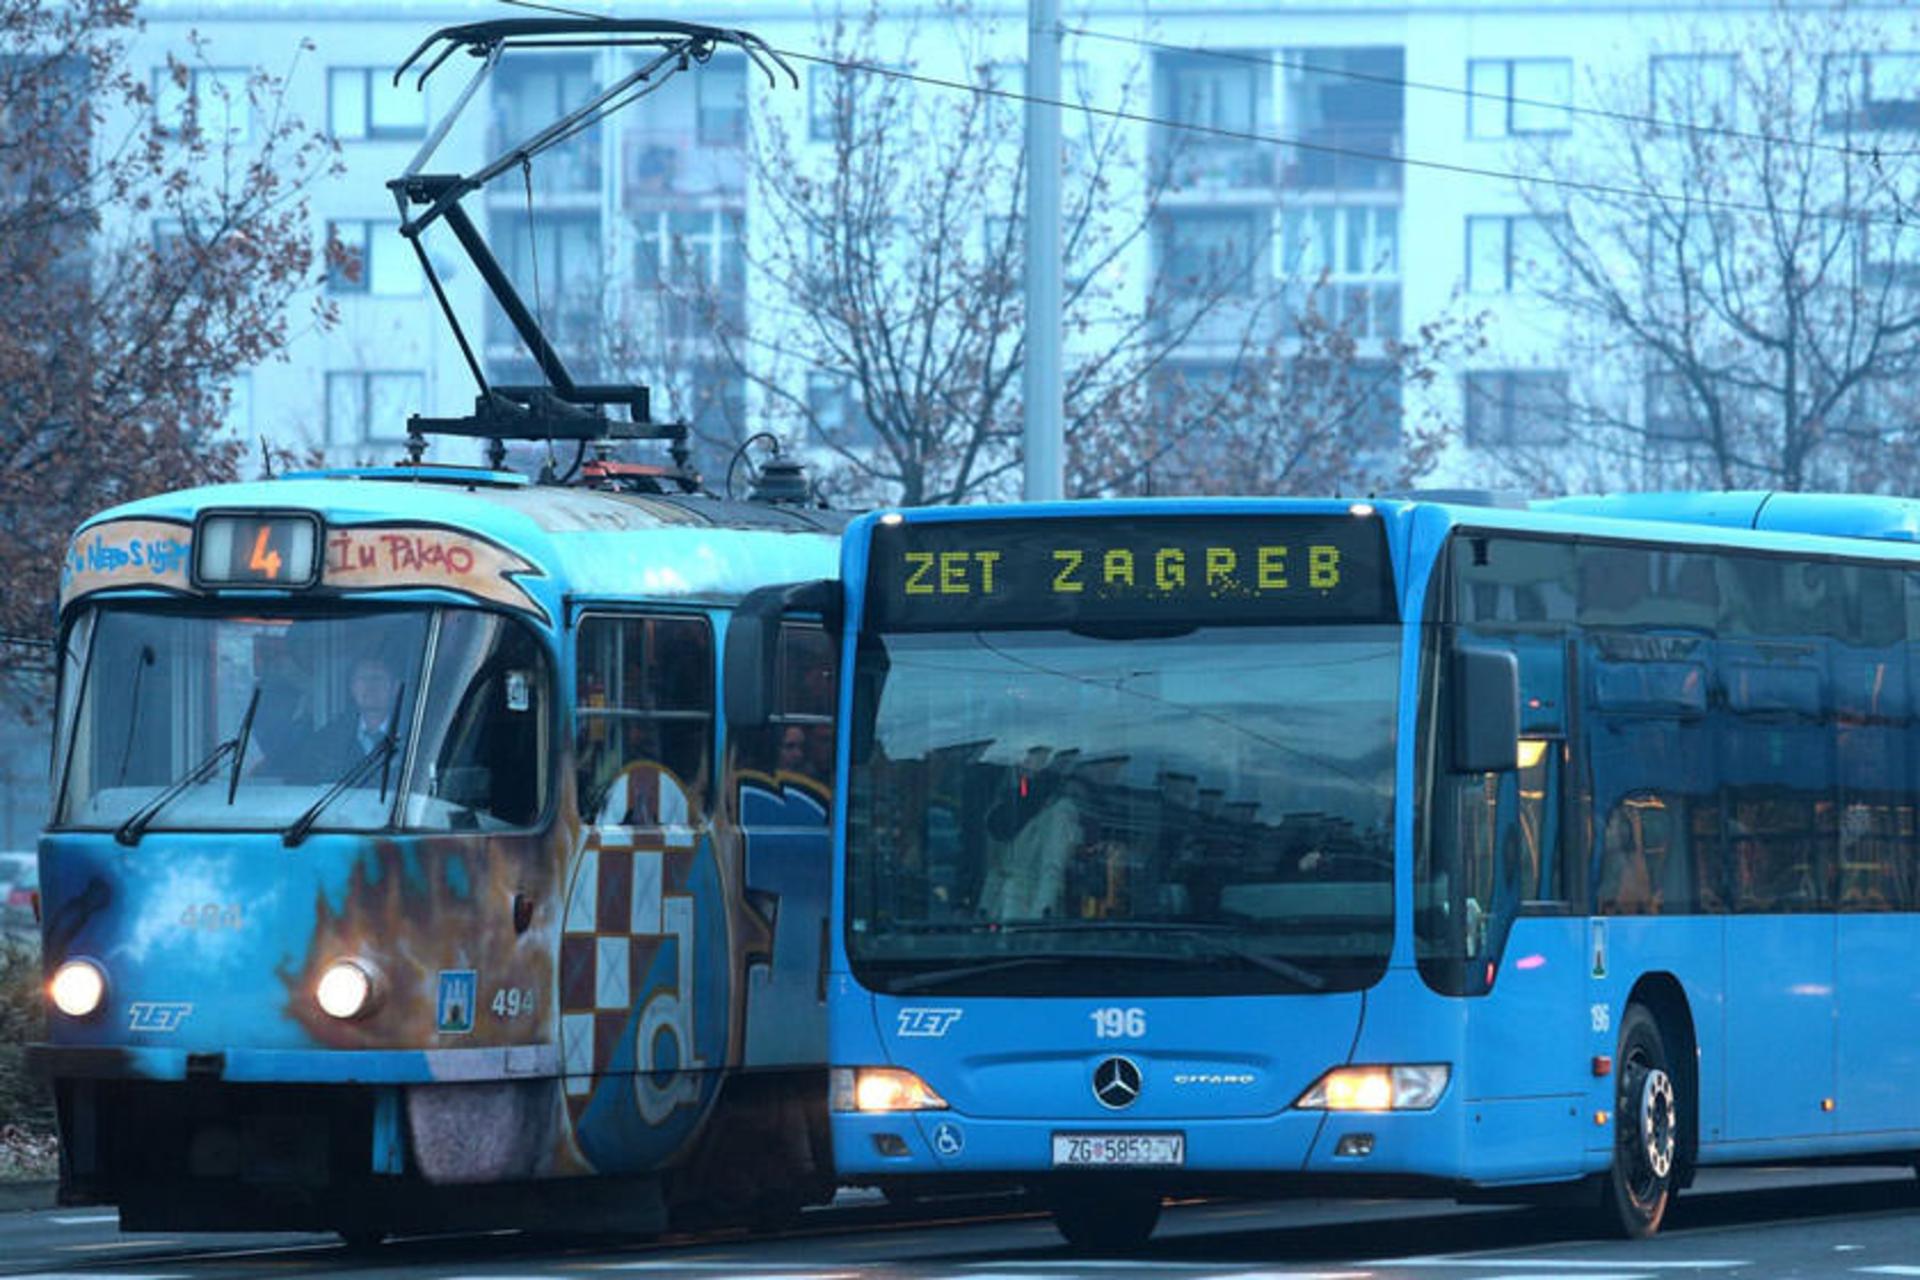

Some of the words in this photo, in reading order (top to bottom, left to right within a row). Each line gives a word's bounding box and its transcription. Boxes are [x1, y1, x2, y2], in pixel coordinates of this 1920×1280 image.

[249, 525, 282, 579] 4
[904, 551, 1001, 594] ZET
[1053, 545, 1342, 597] ZAGREB
[129, 1002, 193, 1031] ZET
[897, 1007, 964, 1037] ZET
[1090, 1007, 1147, 1038] 196
[1067, 1138, 1092, 1162] ZG
